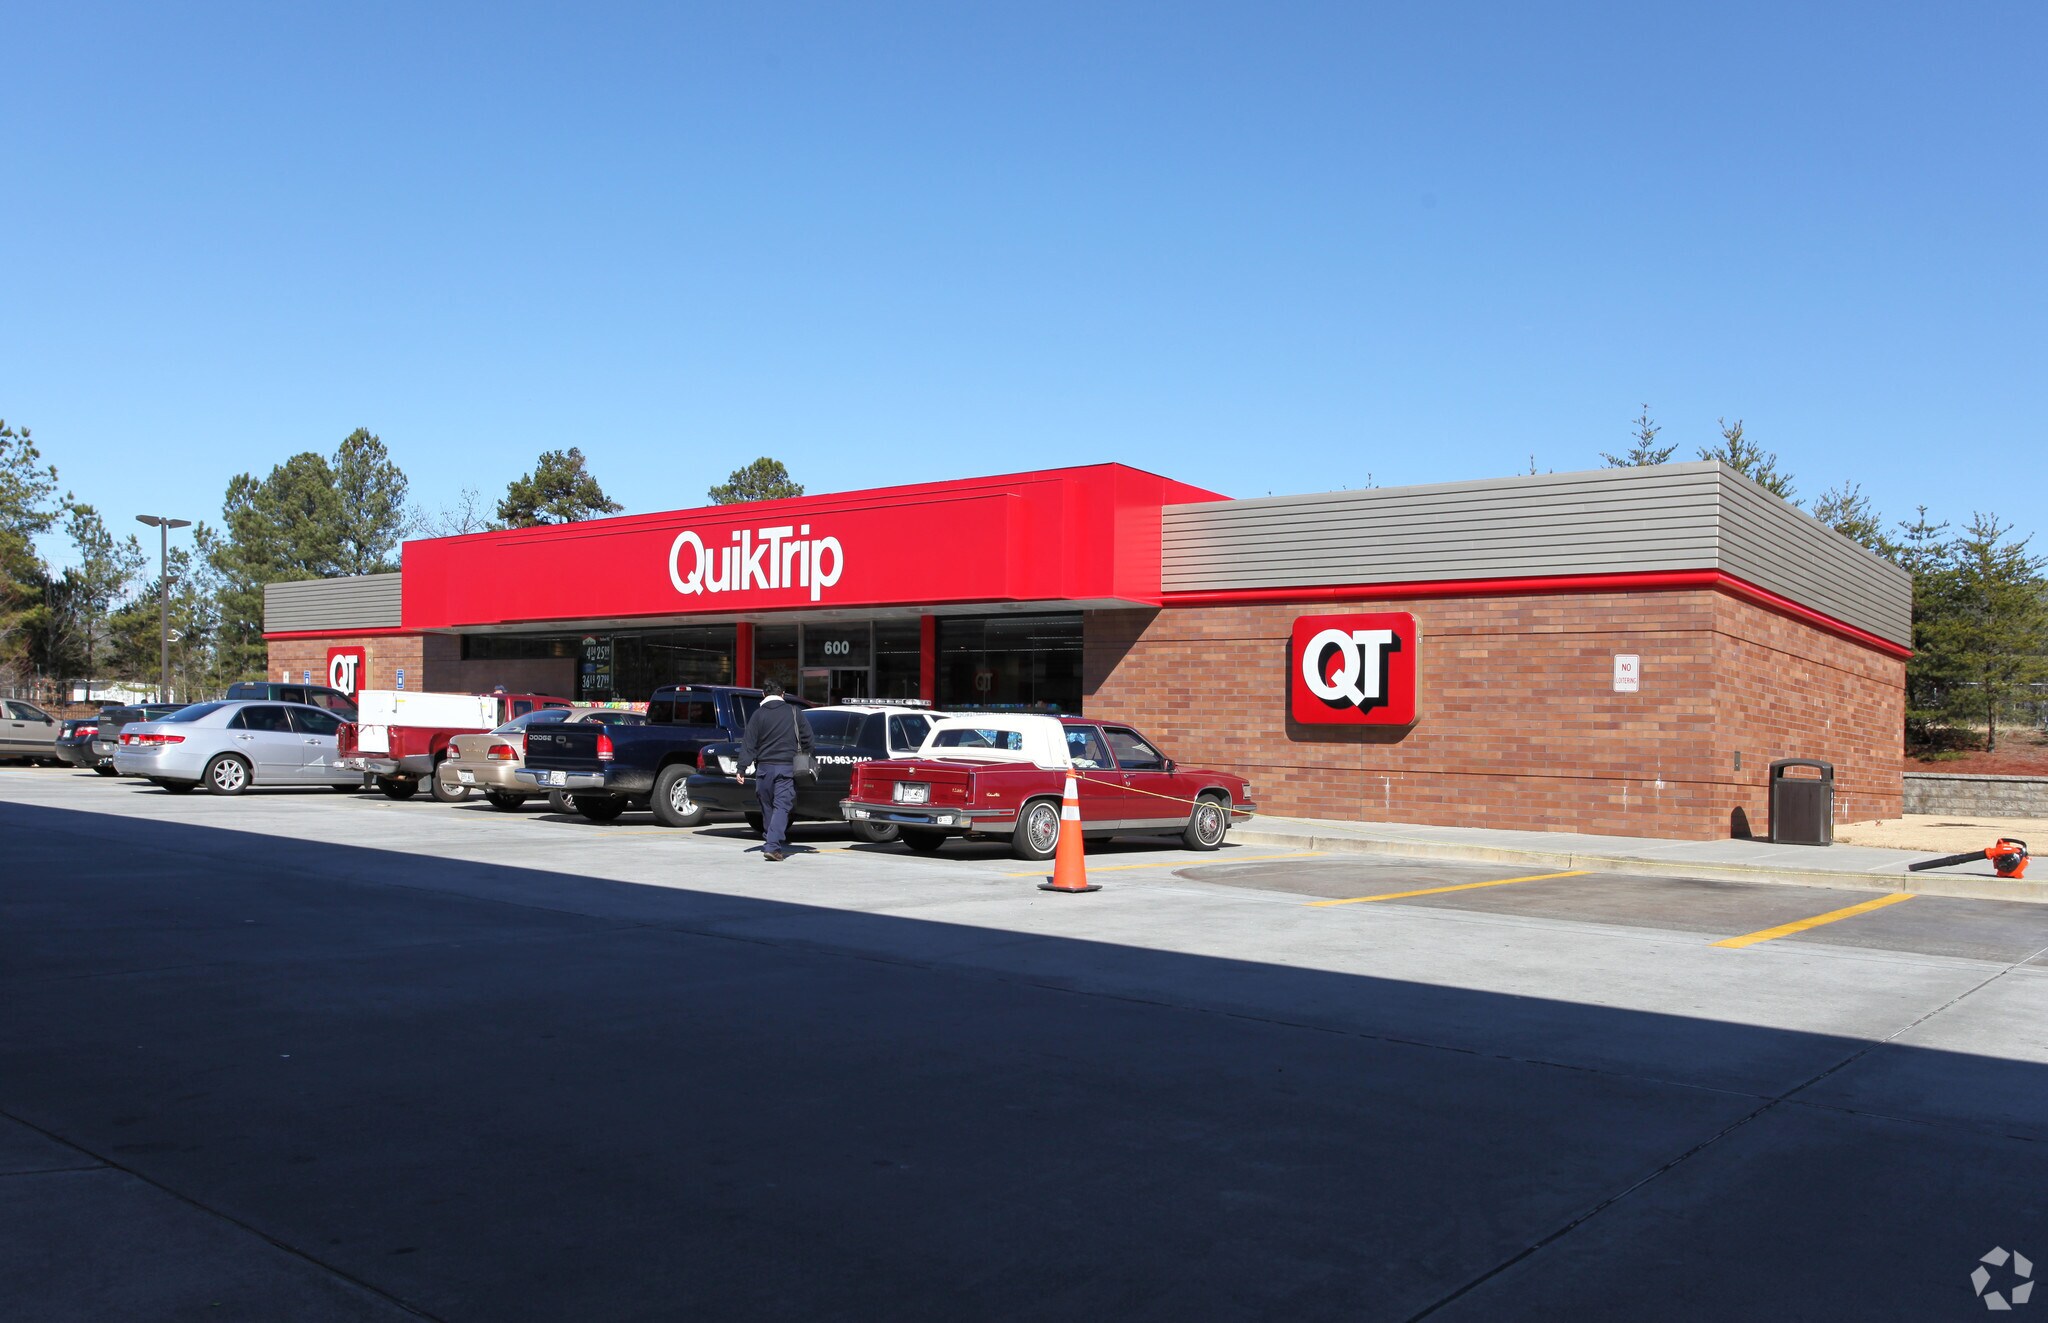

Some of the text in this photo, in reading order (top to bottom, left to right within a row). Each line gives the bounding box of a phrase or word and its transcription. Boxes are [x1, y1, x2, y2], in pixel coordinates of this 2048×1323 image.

[669, 524, 843, 601] QuikTrip
[824, 640, 850, 655] 600
[1621, 663, 1632, 671] NO
[329, 654, 358, 696] QT
[1302, 629, 1394, 709] QT
